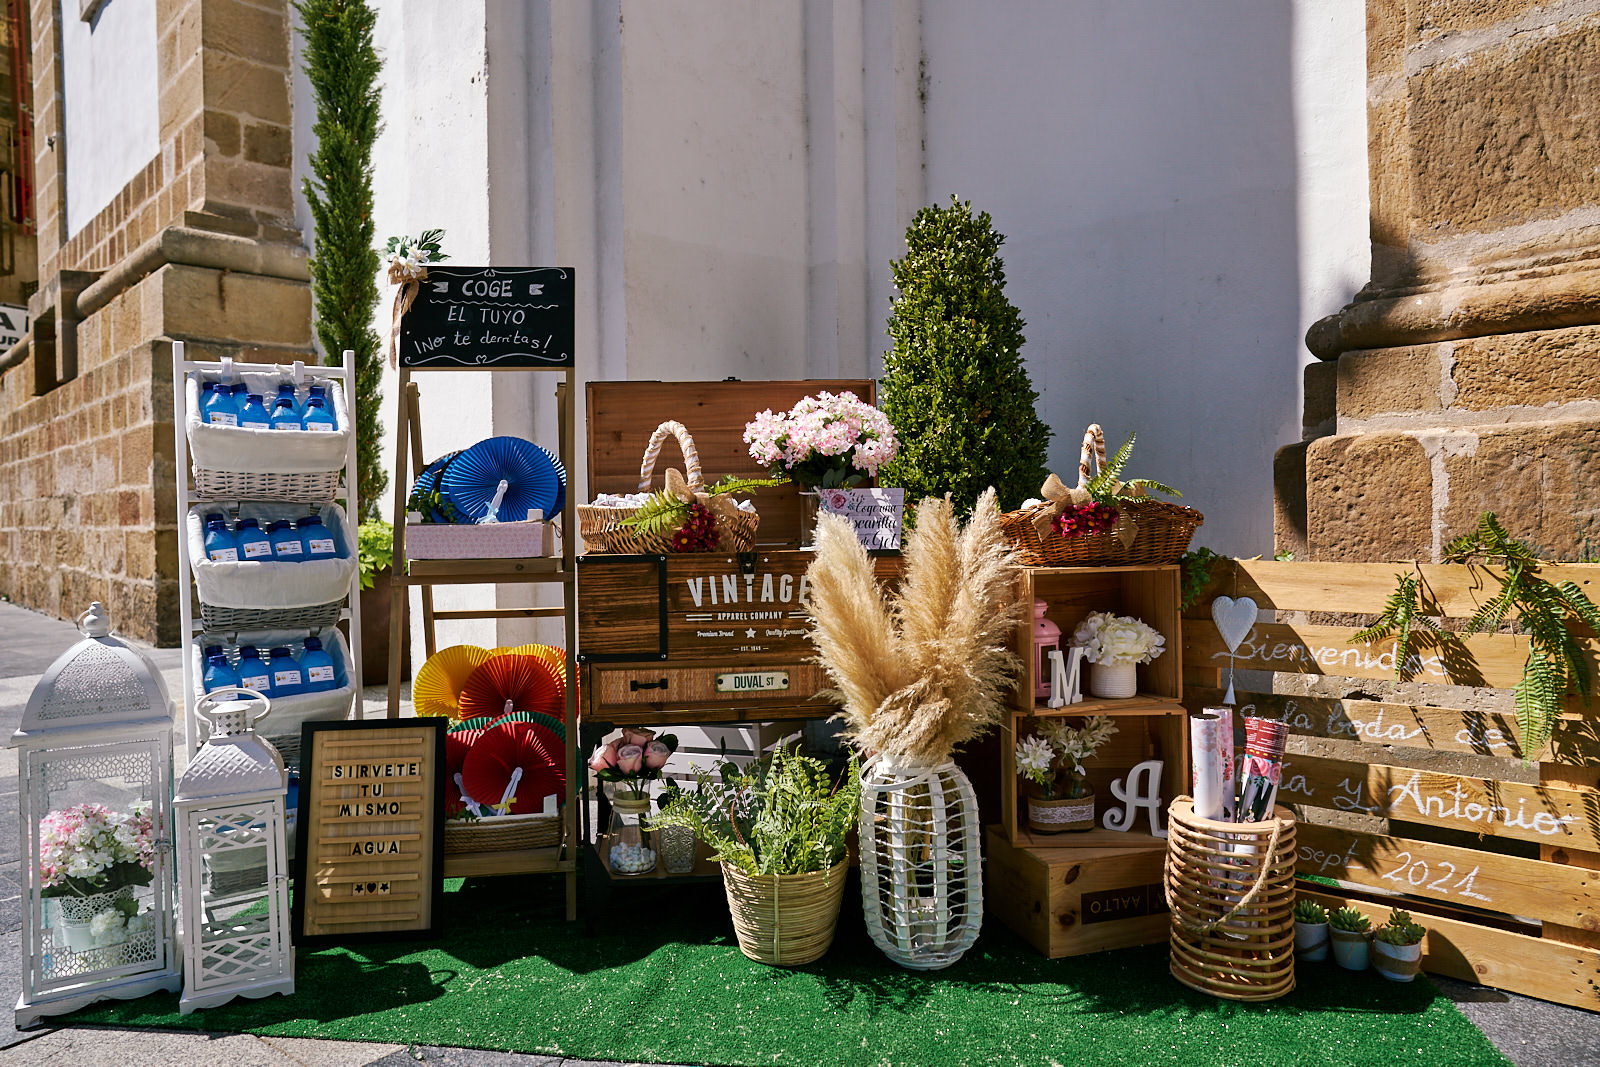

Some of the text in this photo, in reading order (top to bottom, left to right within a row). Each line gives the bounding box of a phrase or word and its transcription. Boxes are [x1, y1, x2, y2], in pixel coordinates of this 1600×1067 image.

[462, 279, 513, 298] COGE
[447, 305, 525, 325] EL TUYO
[453, 330, 472, 346] te
[686, 573, 811, 608] VINTAGE
[717, 611, 783, 621] APPAREL COMPANY
[697, 629, 718, 638] Premium
[719, 629, 734, 637] Brand
[765, 628, 782, 638] Quality
[1211, 626, 1450, 677] Bienvenidos
[734, 675, 774, 689] DUVAL ST
[1048, 646, 1085, 708] M
[1327, 701, 1428, 741] boda
[334, 763, 417, 779] SIRVETE
[361, 784, 382, 797] TU
[1102, 760, 1168, 839] A
[339, 802, 400, 817] MISMO
[1388, 771, 1582, 836] Antonio
[352, 841, 399, 856] AGUA
[1382, 851, 1492, 903] 2021
[1090, 895, 1141, 914] AALTO
